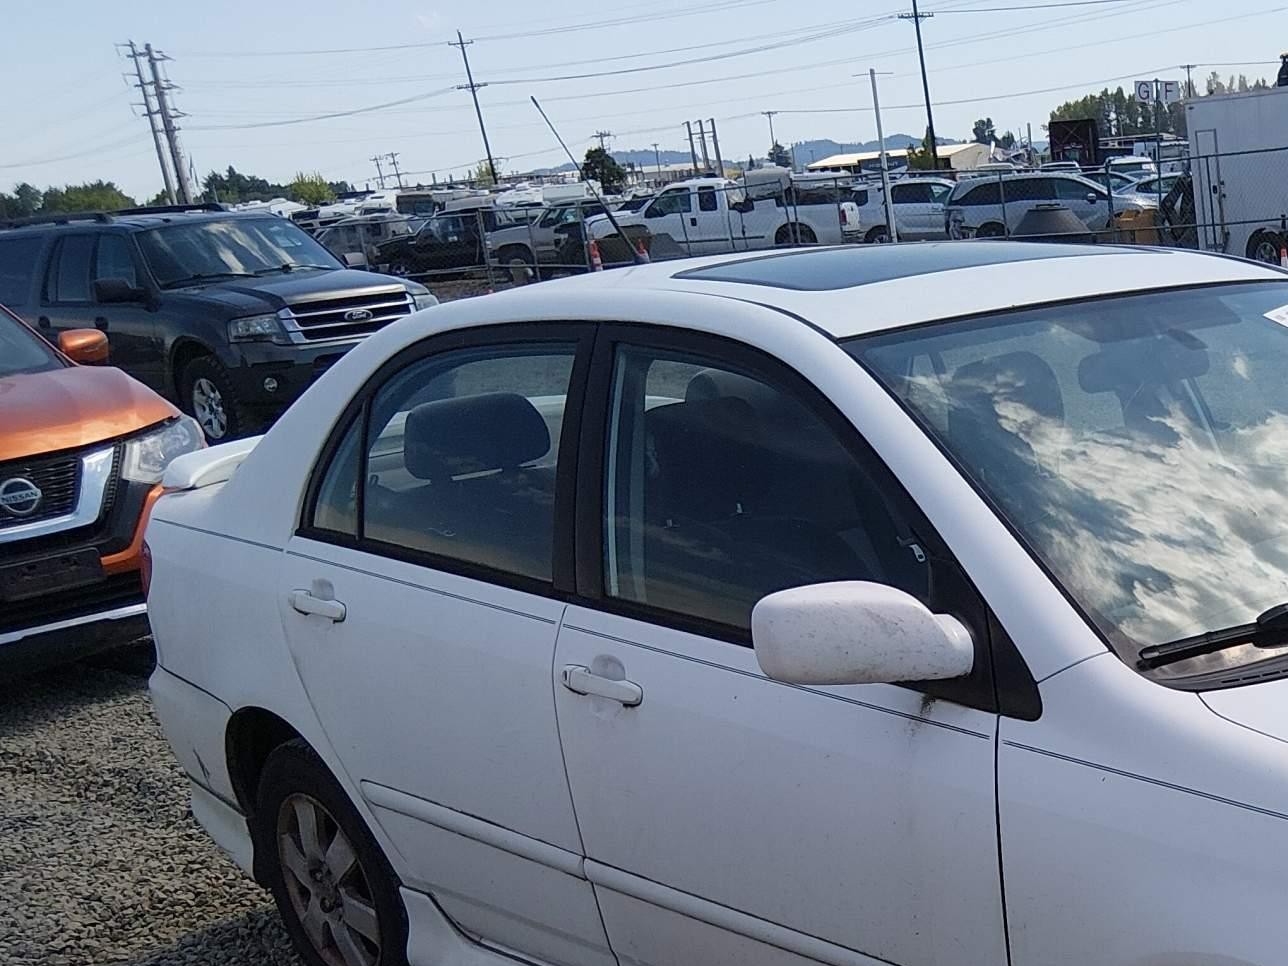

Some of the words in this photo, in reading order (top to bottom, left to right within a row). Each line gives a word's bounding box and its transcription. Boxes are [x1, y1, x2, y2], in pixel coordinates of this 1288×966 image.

[1137, 82, 1150, 100] G
[1164, 82, 1174, 100] F
[1, 490, 38, 504] NISSAN
